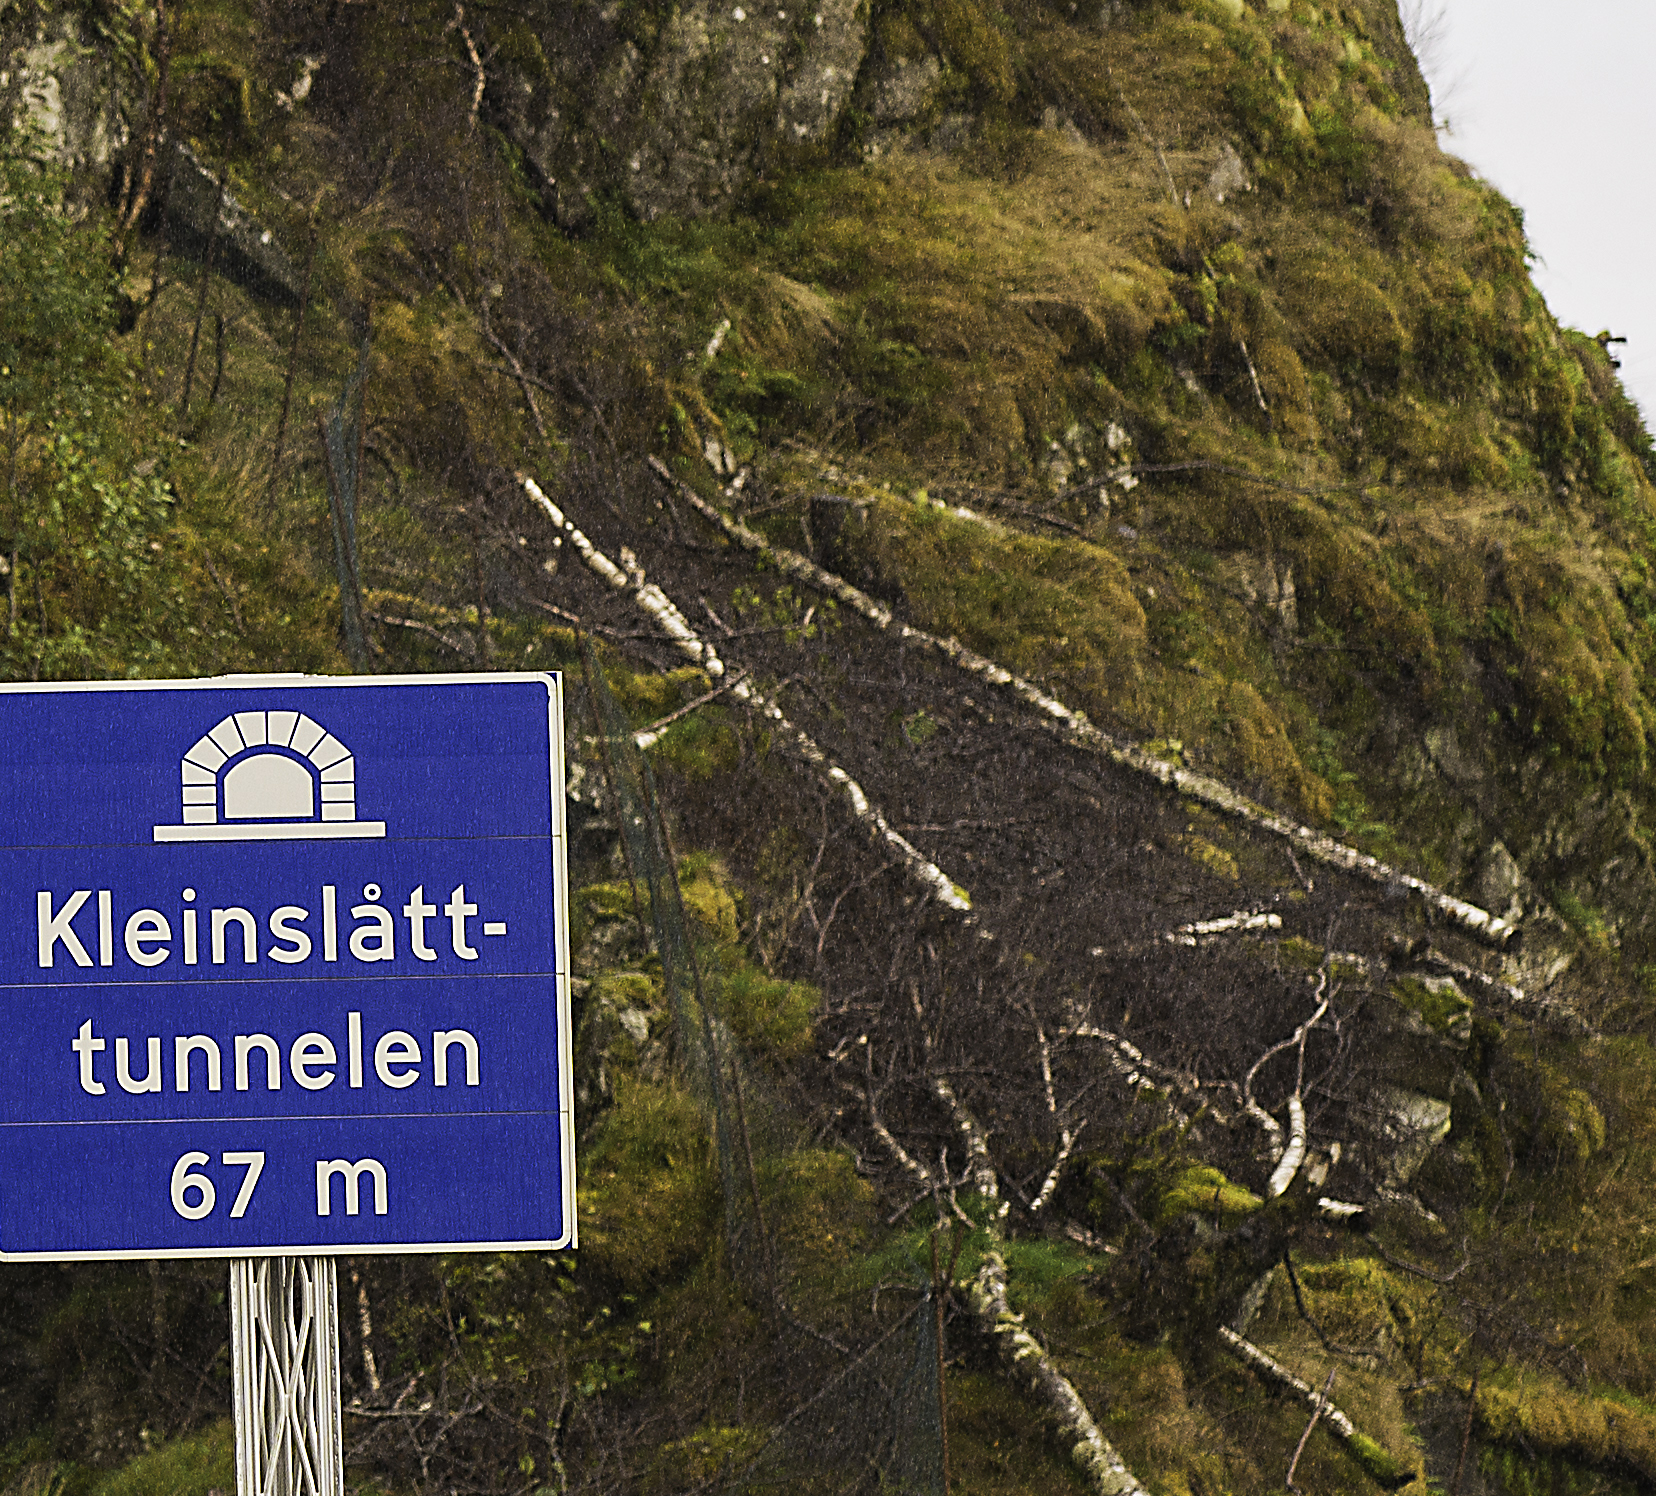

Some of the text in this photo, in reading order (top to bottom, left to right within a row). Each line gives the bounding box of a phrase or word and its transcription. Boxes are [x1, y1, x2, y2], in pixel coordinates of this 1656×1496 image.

[36, 883, 508, 968] Kleinslått-
[71, 1011, 480, 1095] tunnelen
[170, 1151, 388, 1220] 67 m
